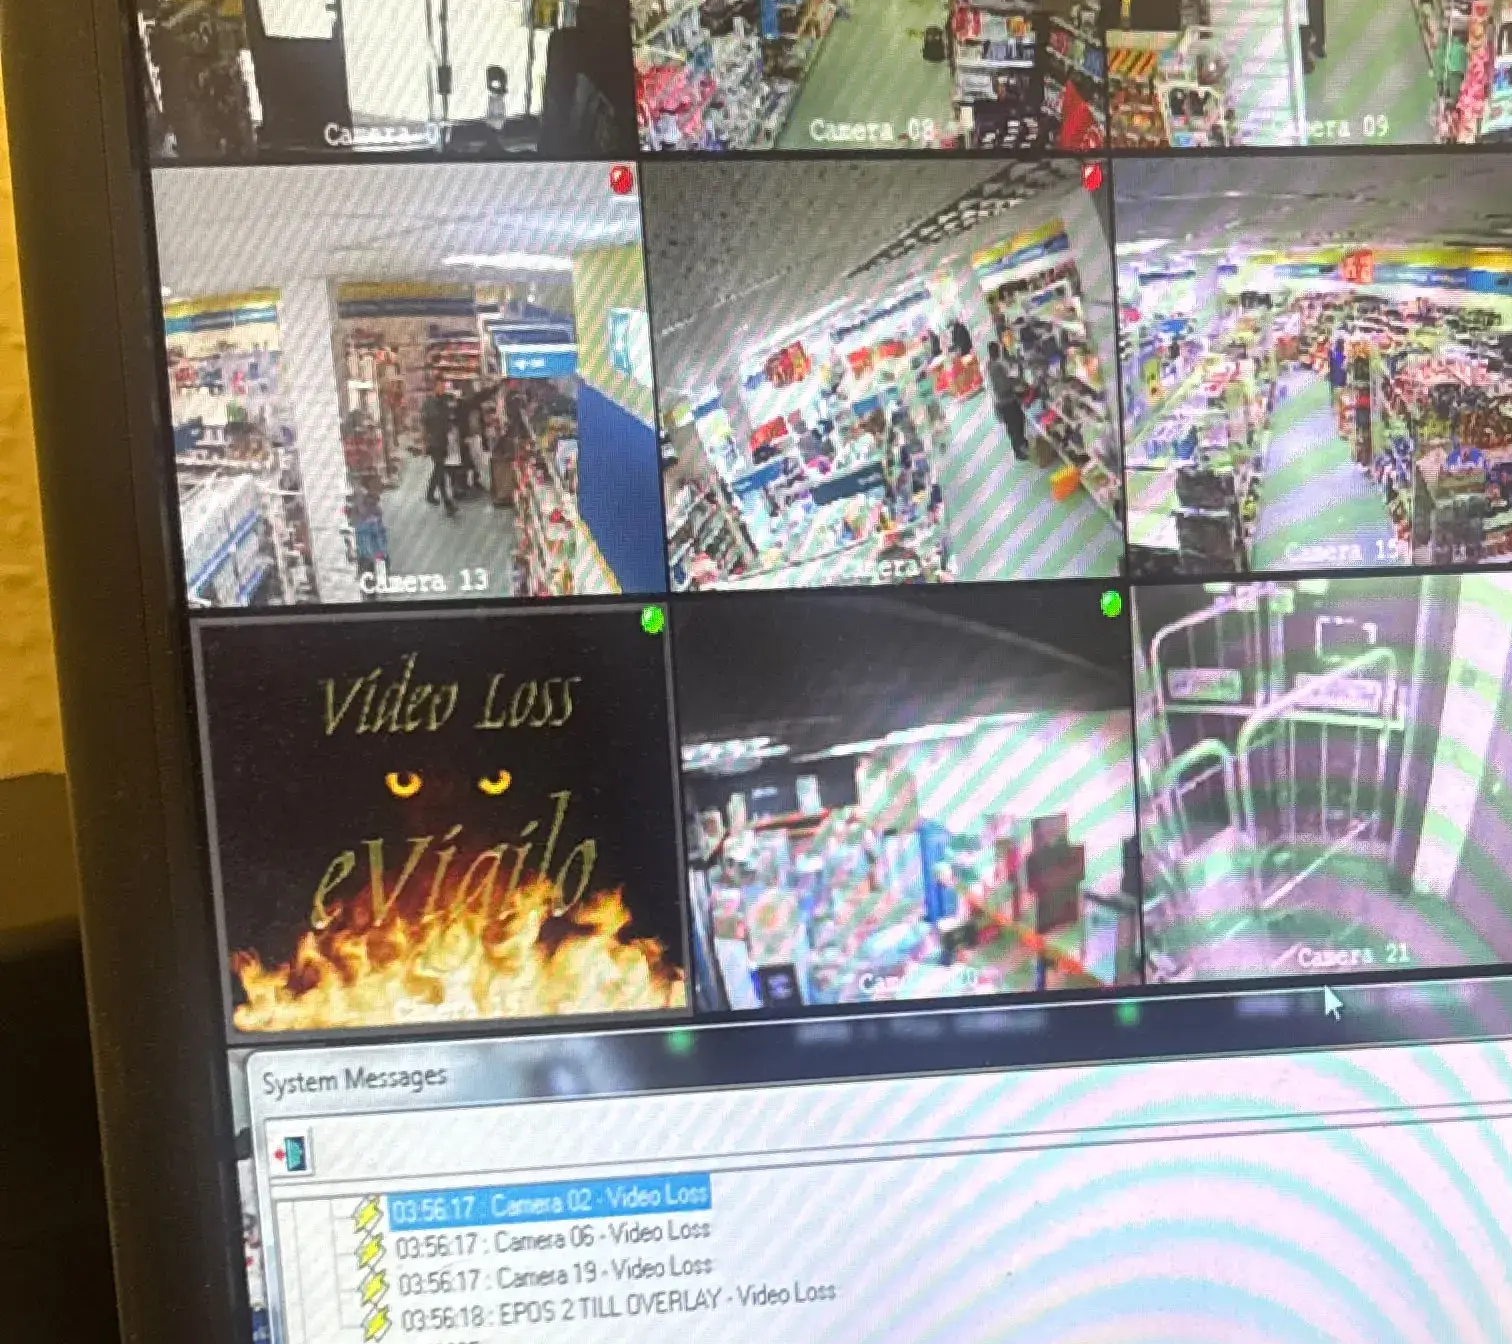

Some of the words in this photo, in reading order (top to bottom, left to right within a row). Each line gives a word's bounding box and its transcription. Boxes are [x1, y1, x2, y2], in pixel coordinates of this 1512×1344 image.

[809, 117, 894, 141] Camera
[1362, 114, 1389, 137] 09
[360, 570, 446, 594] Camera
[459, 566, 489, 592] 13
[322, 652, 460, 736] Video
[473, 673, 582, 730] Loss
[309, 790, 598, 974] eVigilo
[1298, 944, 1374, 967] Camera
[1386, 941, 1410, 964] 21
[262, 1071, 338, 1101] System
[343, 1066, 448, 1094] Messages
[392, 1196, 477, 1223] 03:56:17
[490, 1193, 563, 1217] Camera
[568, 1188, 592, 1212] 02
[605, 1185, 661, 1208] Video
[664, 1182, 710, 1205] Loss
[395, 1231, 478, 1260] 03:56:17
[494, 1230, 566, 1254] Camera
[570, 1224, 595, 1248] 06
[608, 1220, 663, 1245] Video
[667, 1218, 711, 1241] Loss
[399, 1268, 481, 1297] 03:56:17
[497, 1265, 569, 1290] Camera
[574, 1259, 597, 1284] 19
[611, 1256, 665, 1281] Video
[669, 1253, 713, 1277] Loss
[402, 1306, 485, 1334] 03:56:18
[500, 1300, 555, 1327] EPOS
[560, 1298, 575, 1323] 2
[580, 1294, 623, 1320] TILL
[627, 1287, 723, 1315] OVERLAY
[735, 1281, 790, 1307] Video
[794, 1278, 837, 1304] Loss
